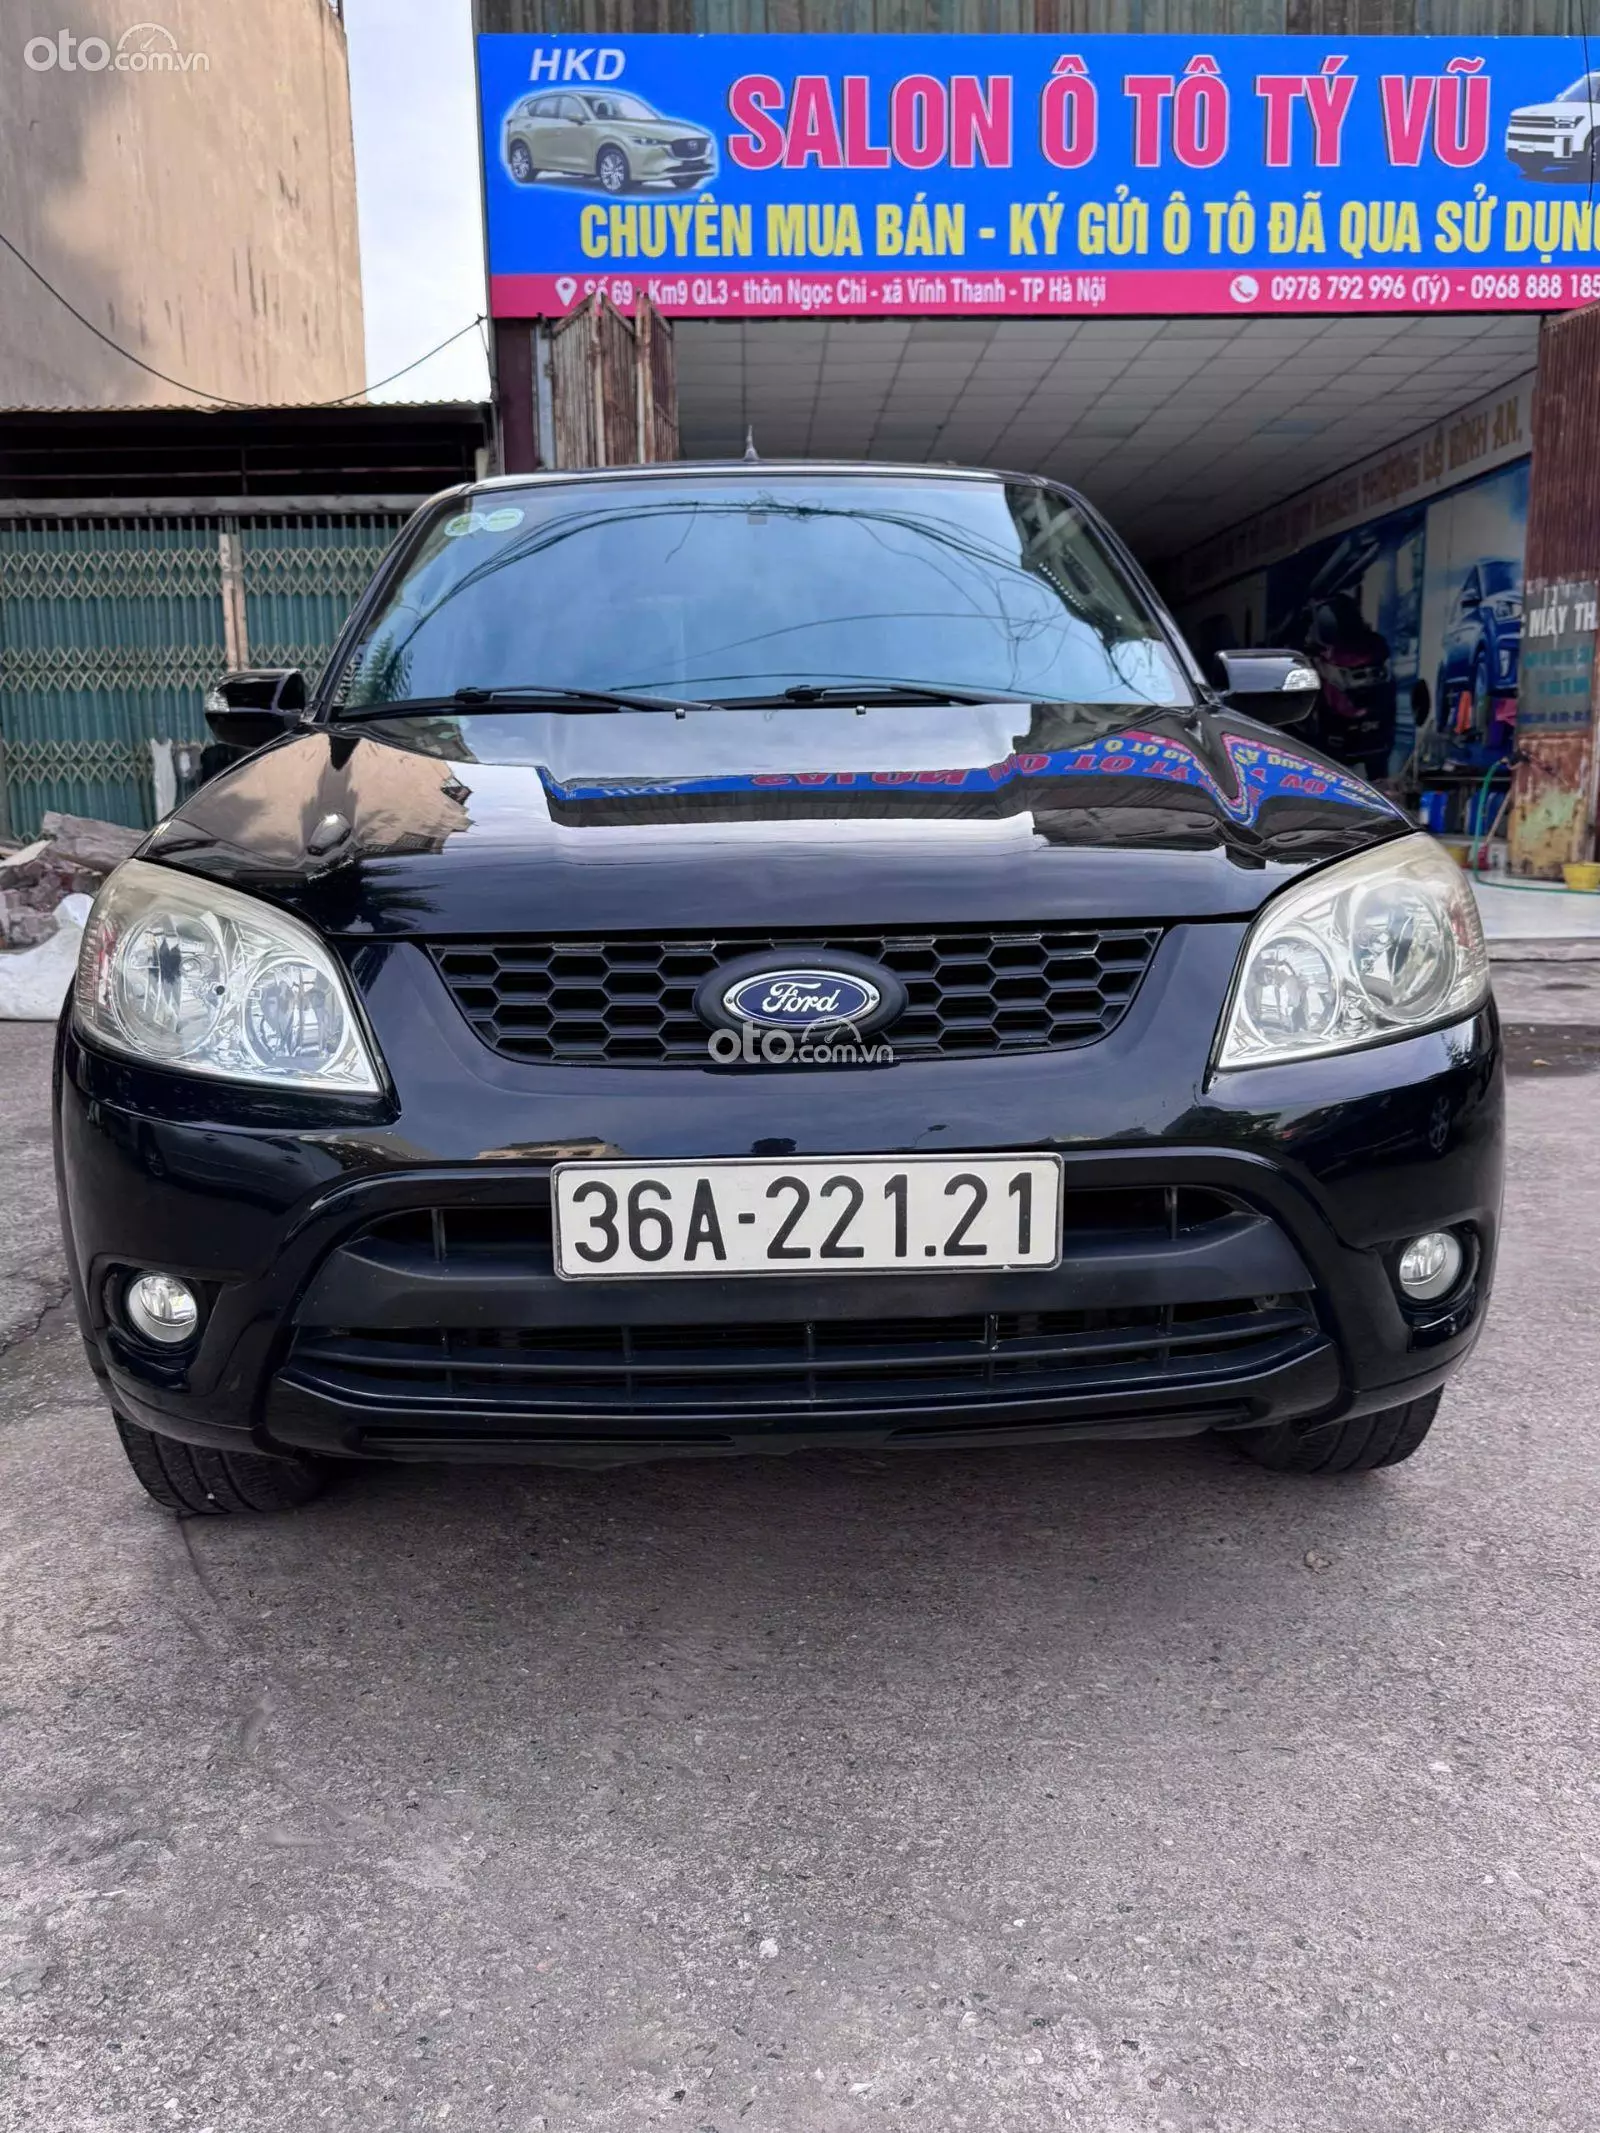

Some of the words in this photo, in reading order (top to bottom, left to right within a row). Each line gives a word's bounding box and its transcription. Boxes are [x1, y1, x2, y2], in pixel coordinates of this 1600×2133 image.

[529, 48, 626, 81] HKD
[728, 74, 1012, 170] SALON
[1040, 54, 1098, 169] Ô
[1123, 54, 1229, 169] TÔ
[1255, 55, 1358, 168] TÝ
[1380, 56, 1491, 168] VŨ
[580, 193, 751, 257] CHUYÊN
[767, 204, 862, 256] MUA
[877, 193, 965, 255] BÁN
[1010, 191, 1064, 254] KÝ
[1077, 184, 1148, 255] GỬI
[1163, 192, 1190, 254] Ô
[1204, 191, 1255, 253] TÔ
[1268, 192, 1325, 253] ĐÃ
[1340, 202, 1421, 257] QUA
[1435, 184, 1497, 254] SỬ
[1505, 201, 1600, 263] DỤN
[611, 279, 633, 305] 69
[647, 279, 689, 305] Km9
[691, 278, 729, 306] QL3
[742, 278, 783, 305] thôn
[787, 278, 833, 311] Ngọc
[836, 277, 867, 305] Chi
[881, 278, 902, 304] xã
[906, 277, 947, 304] Vĩnh
[950, 277, 1006, 304] Thanh
[1020, 277, 1044, 303] TP
[1048, 276, 1073, 303] Hà
[1076, 276, 1106, 307] Nội
[1271, 275, 1321, 301] 0978
[1326, 275, 1363, 300] 792
[1367, 275, 1406, 300] 996
[1411, 274, 1450, 304] (Tý)
[1470, 274, 1521, 300] 0968
[1525, 273, 1563, 299] 888
[761, 981, 842, 1014] Ford
[572, 1173, 1033, 1263] 36A-221.21
